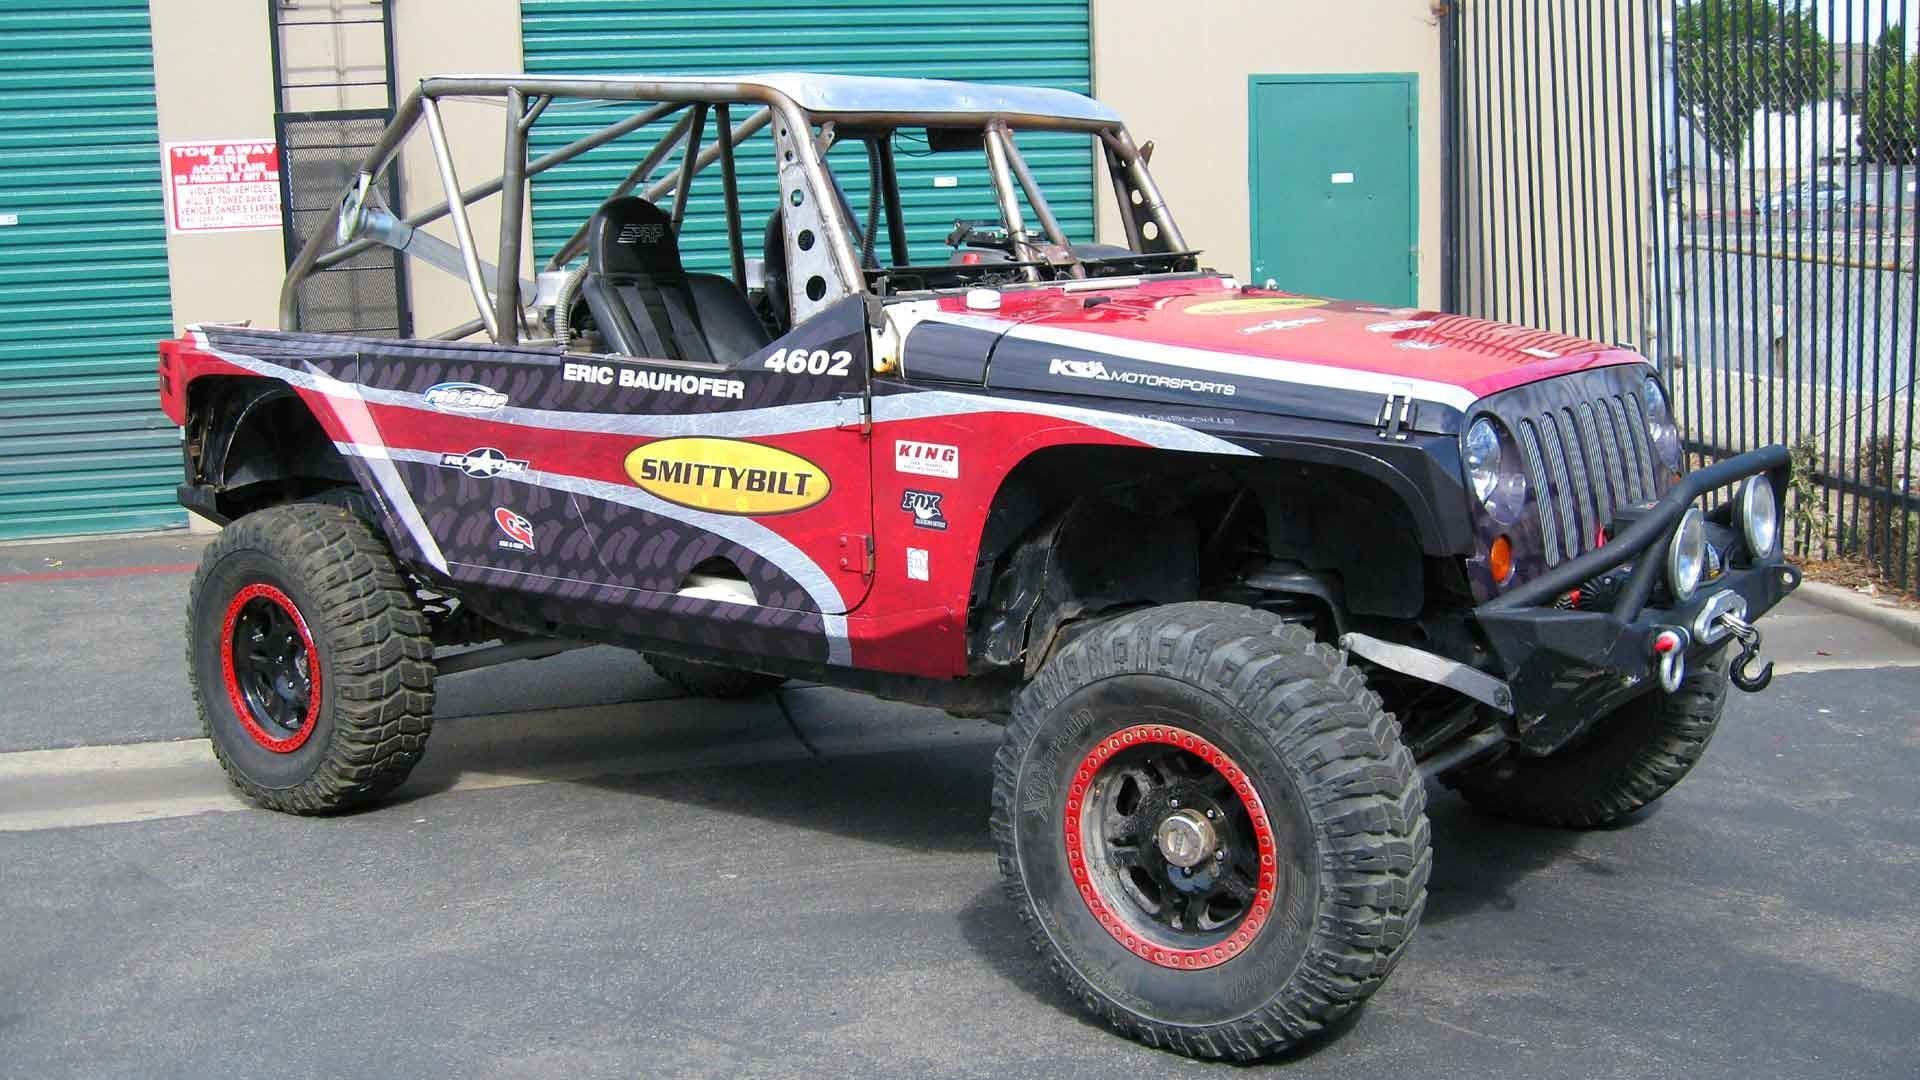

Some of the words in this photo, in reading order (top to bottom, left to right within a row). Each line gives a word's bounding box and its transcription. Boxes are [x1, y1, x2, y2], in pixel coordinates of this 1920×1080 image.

[174, 146, 216, 157] TOW
[224, 144, 277, 154] AWAY
[208, 154, 248, 165] FIRE
[763, 348, 854, 377] 4602
[563, 363, 614, 385] ERIC
[618, 369, 745, 399] BAUHOFER
[1110, 371, 1236, 396] MOTORSPORTS
[898, 444, 956, 462] KING
[640, 458, 812, 497] SMITTYBILT
[902, 491, 942, 511] FOX
